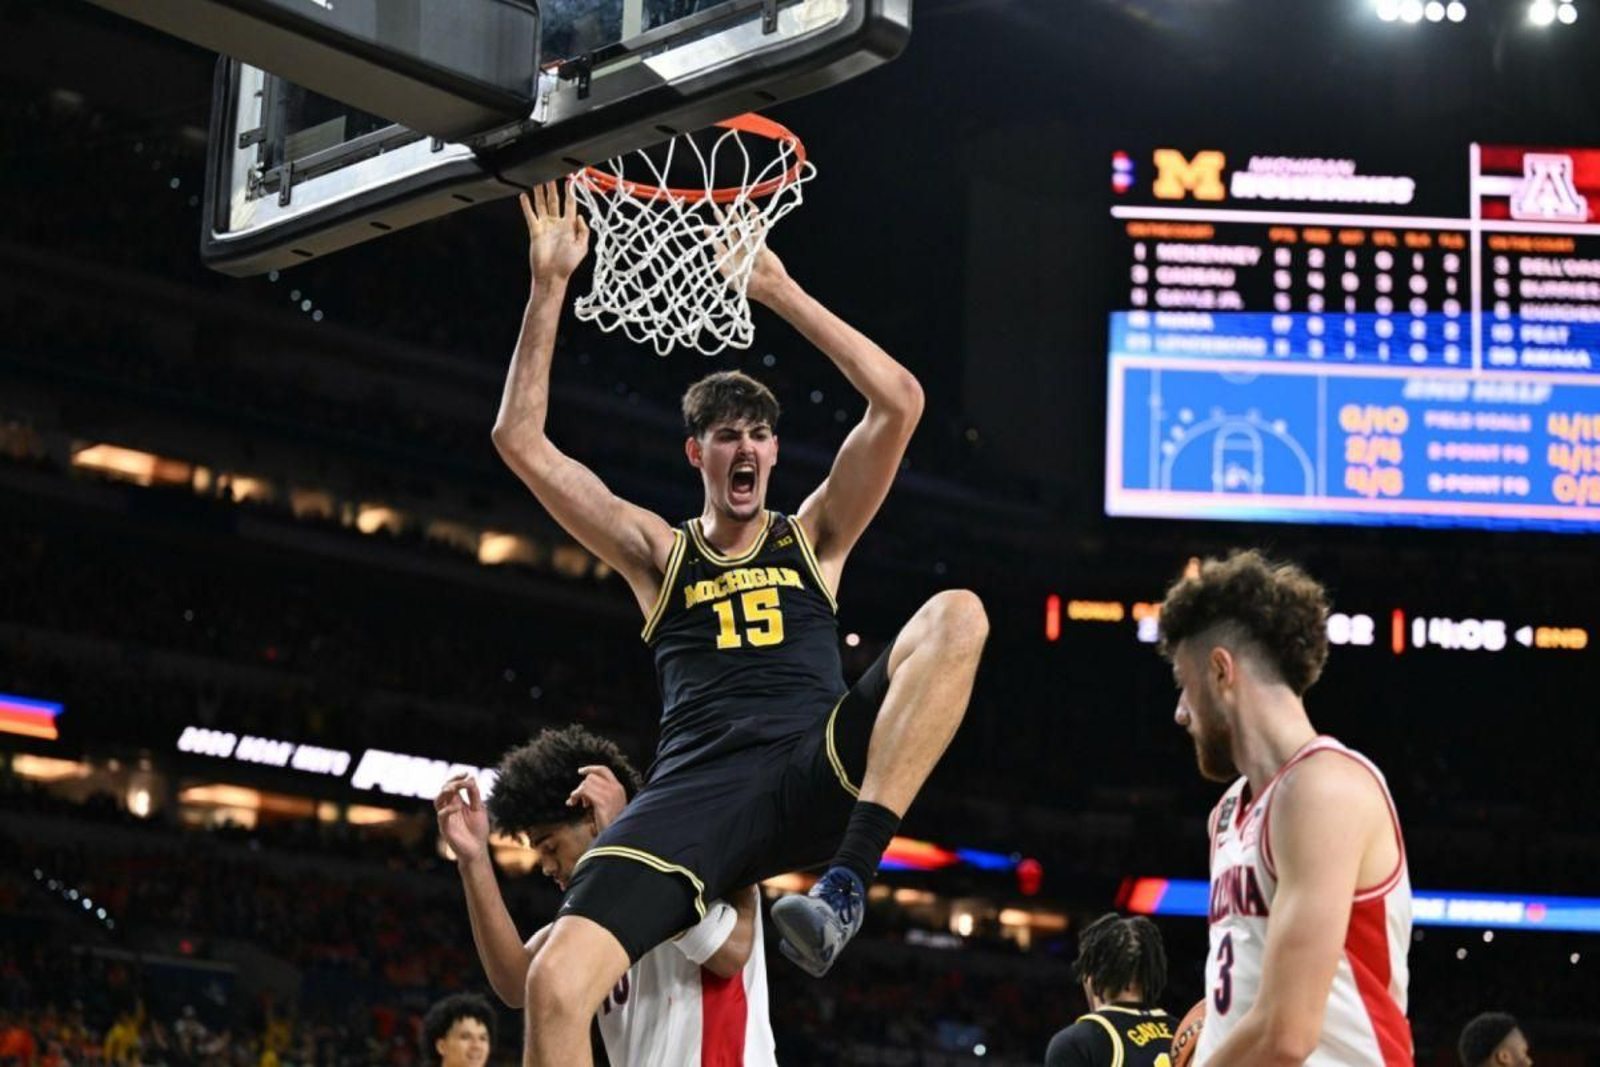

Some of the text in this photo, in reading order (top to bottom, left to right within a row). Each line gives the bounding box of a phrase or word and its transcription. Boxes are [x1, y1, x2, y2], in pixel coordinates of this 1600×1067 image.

[1153, 149, 1225, 199] M
[684, 567, 806, 610] MICHIGAN
[713, 587, 784, 649] 15
[1214, 931, 1234, 1016] 3
[1127, 1021, 1174, 1047] GAYLE
